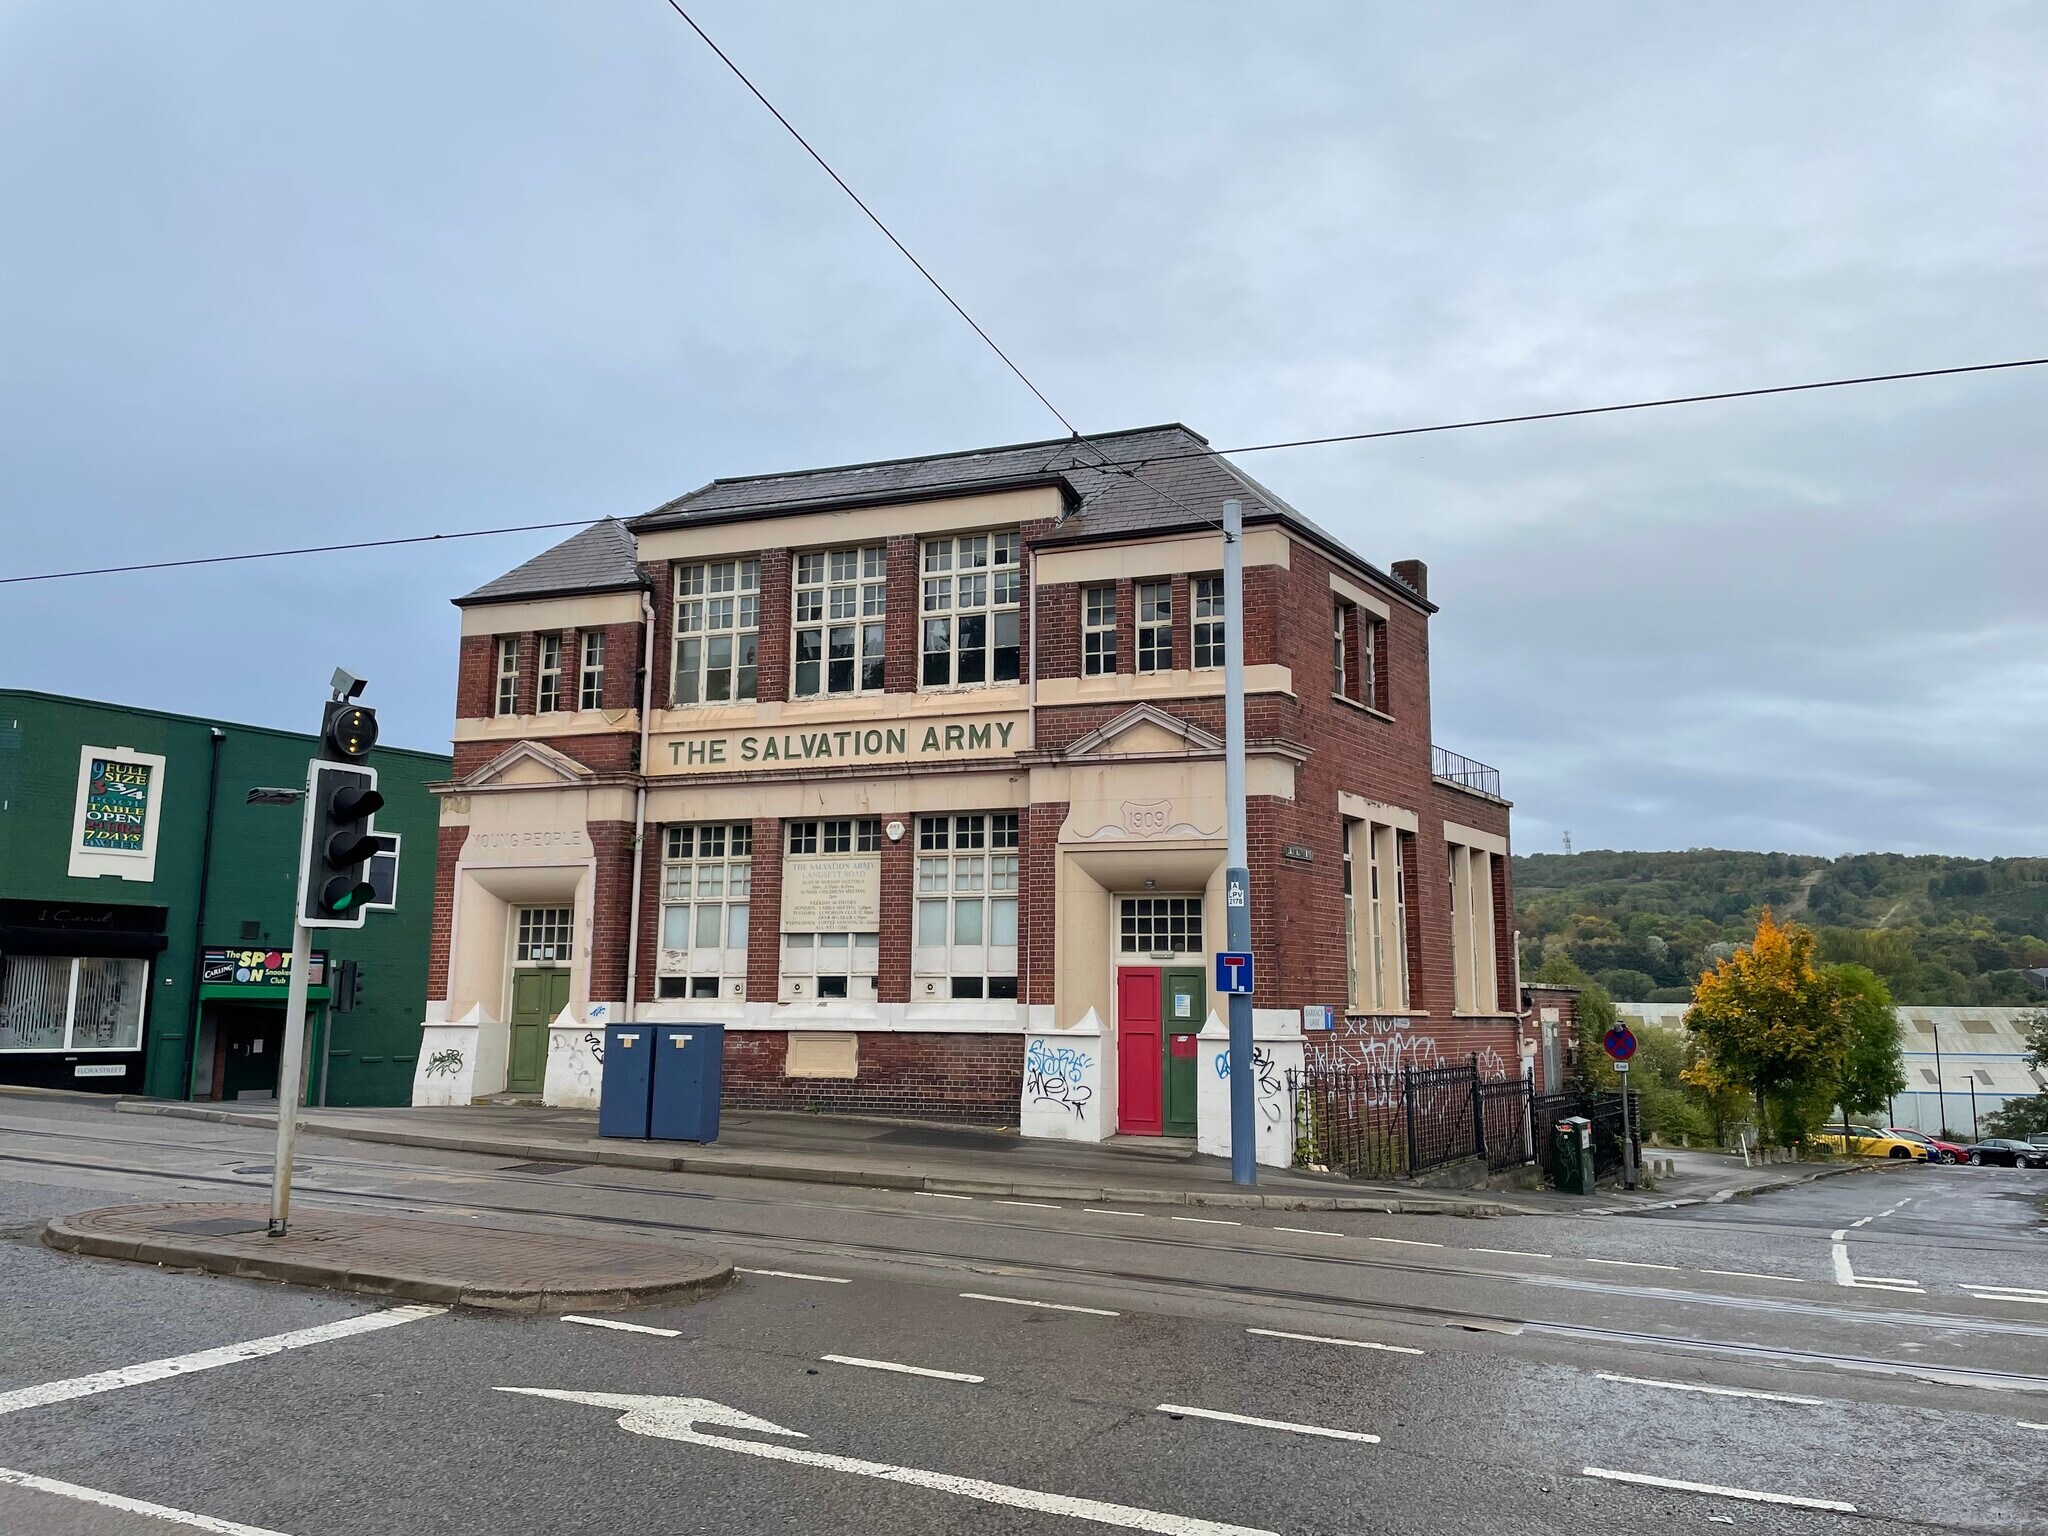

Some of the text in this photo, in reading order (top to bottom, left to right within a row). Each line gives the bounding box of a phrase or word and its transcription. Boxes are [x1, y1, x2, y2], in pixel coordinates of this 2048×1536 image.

[668, 721, 1015, 766] THE SALVATION ARMY
[93, 761, 148, 780] 9 FULL
[104, 773, 147, 785] SIZE
[89, 796, 143, 807] POOL
[88, 803, 145, 816] TABLE
[87, 811, 142, 824] OPEN
[1130, 811, 1164, 828] 1909
[96, 831, 141, 842] DAYS
[473, 830, 581, 848] YOUNG PEOPLE
[793, 862, 875, 871] THE SALVATION ARMY
[225, 950, 293, 969] The SPOT
[204, 964, 233, 979] CARLING
[236, 967, 265, 982] ON
[1309, 1018, 1321, 1026] LANE
[99, 1066, 122, 1074] STREET
